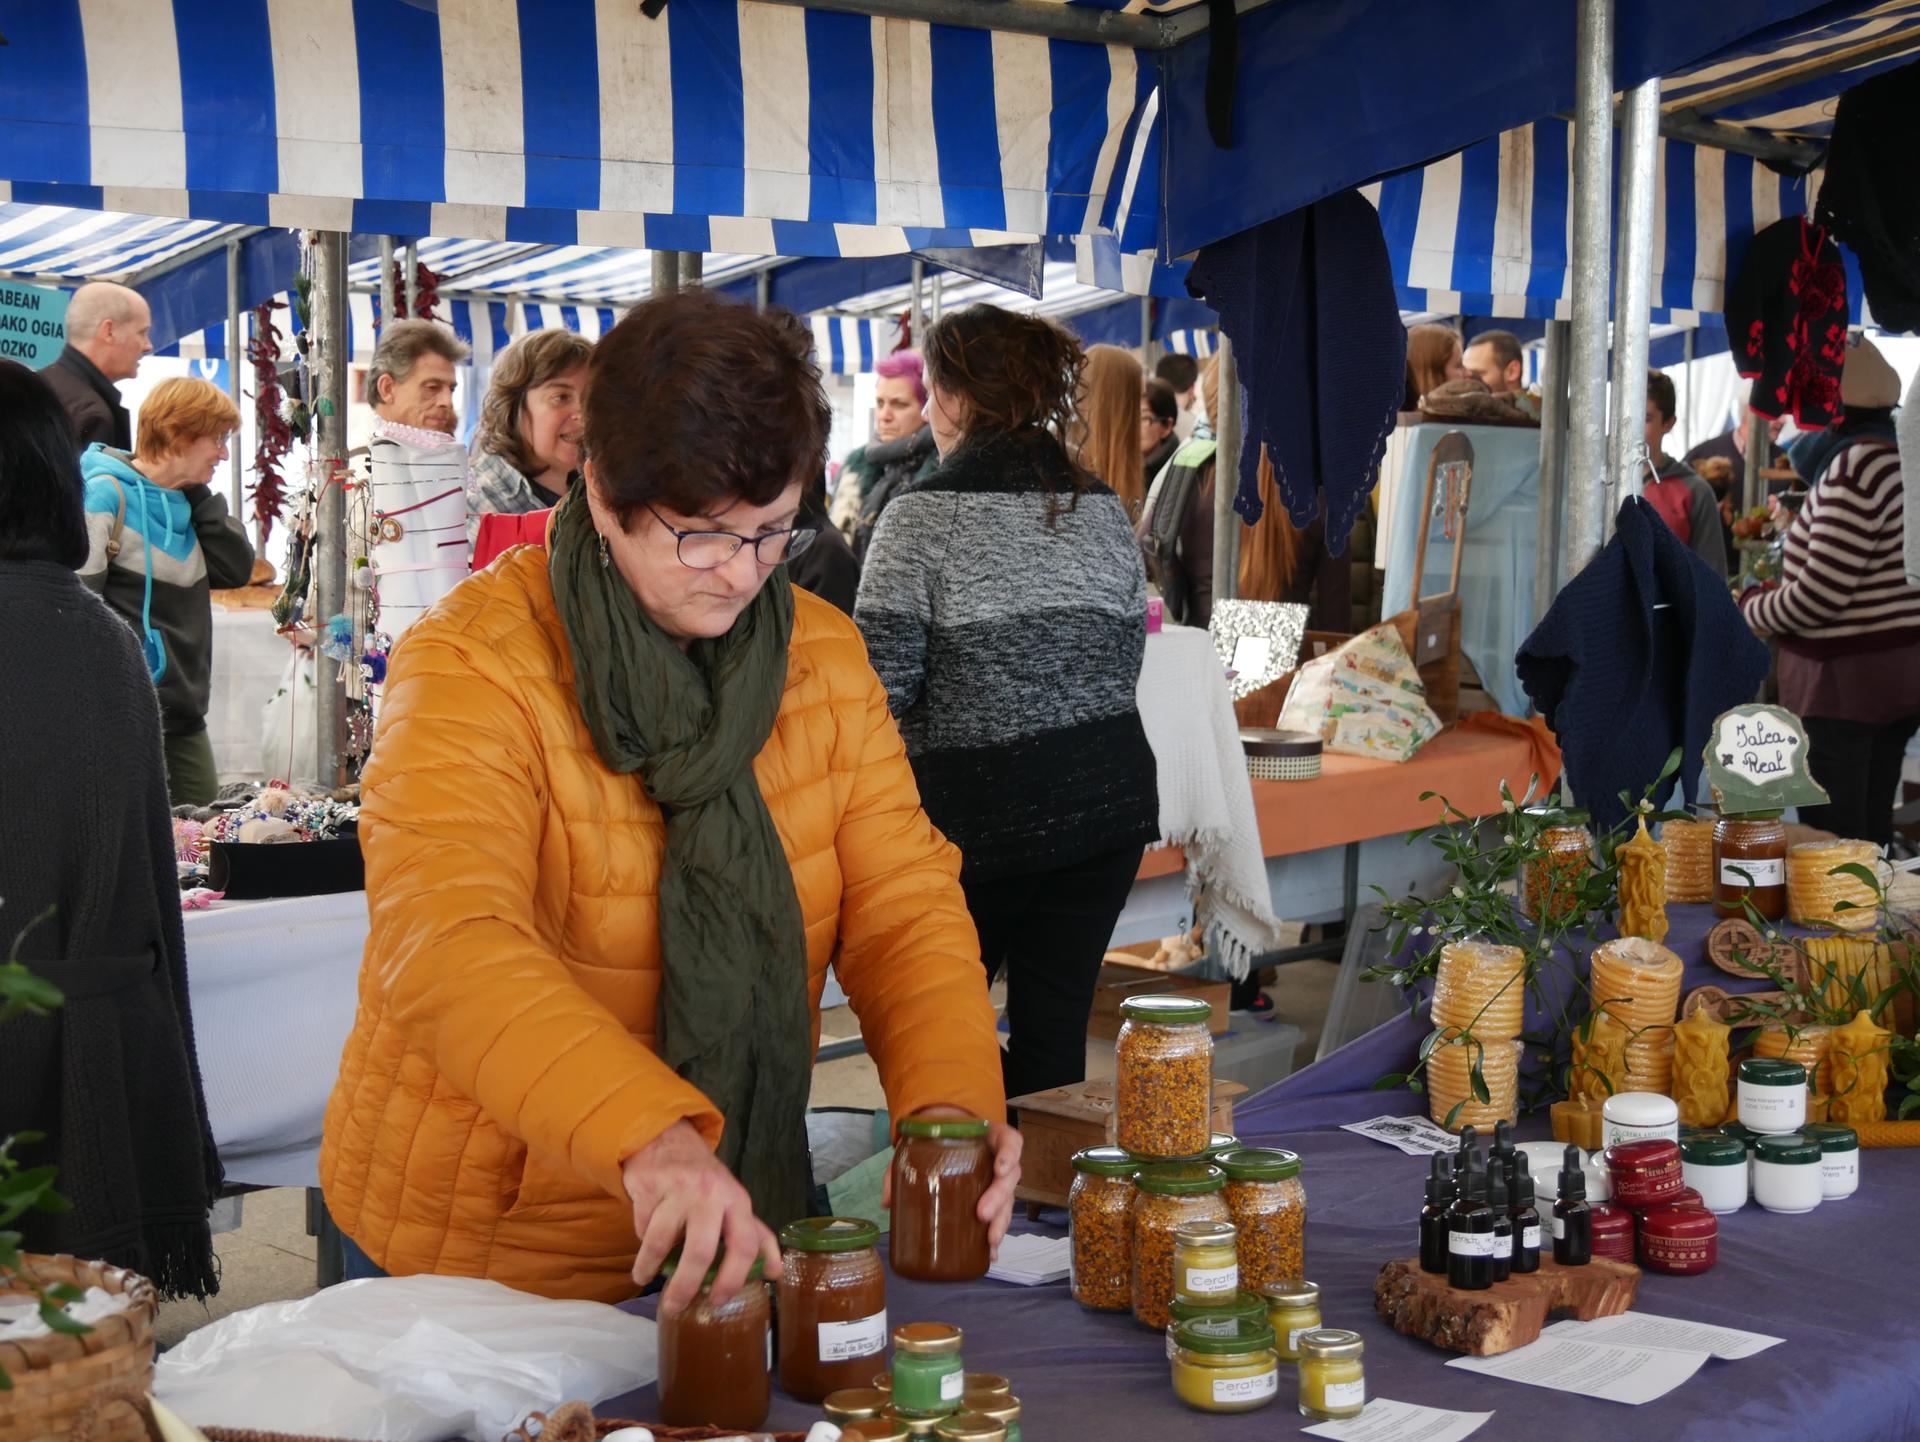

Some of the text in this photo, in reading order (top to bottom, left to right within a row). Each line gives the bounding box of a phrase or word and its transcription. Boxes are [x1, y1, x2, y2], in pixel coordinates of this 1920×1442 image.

[0, 314, 64, 339] AKO OGIA
[0, 339, 37, 359] OZKO
[1742, 750, 1787, 773] Real
[1191, 1272, 1236, 1286] Cerato
[1214, 1379, 1263, 1391] Cerato
